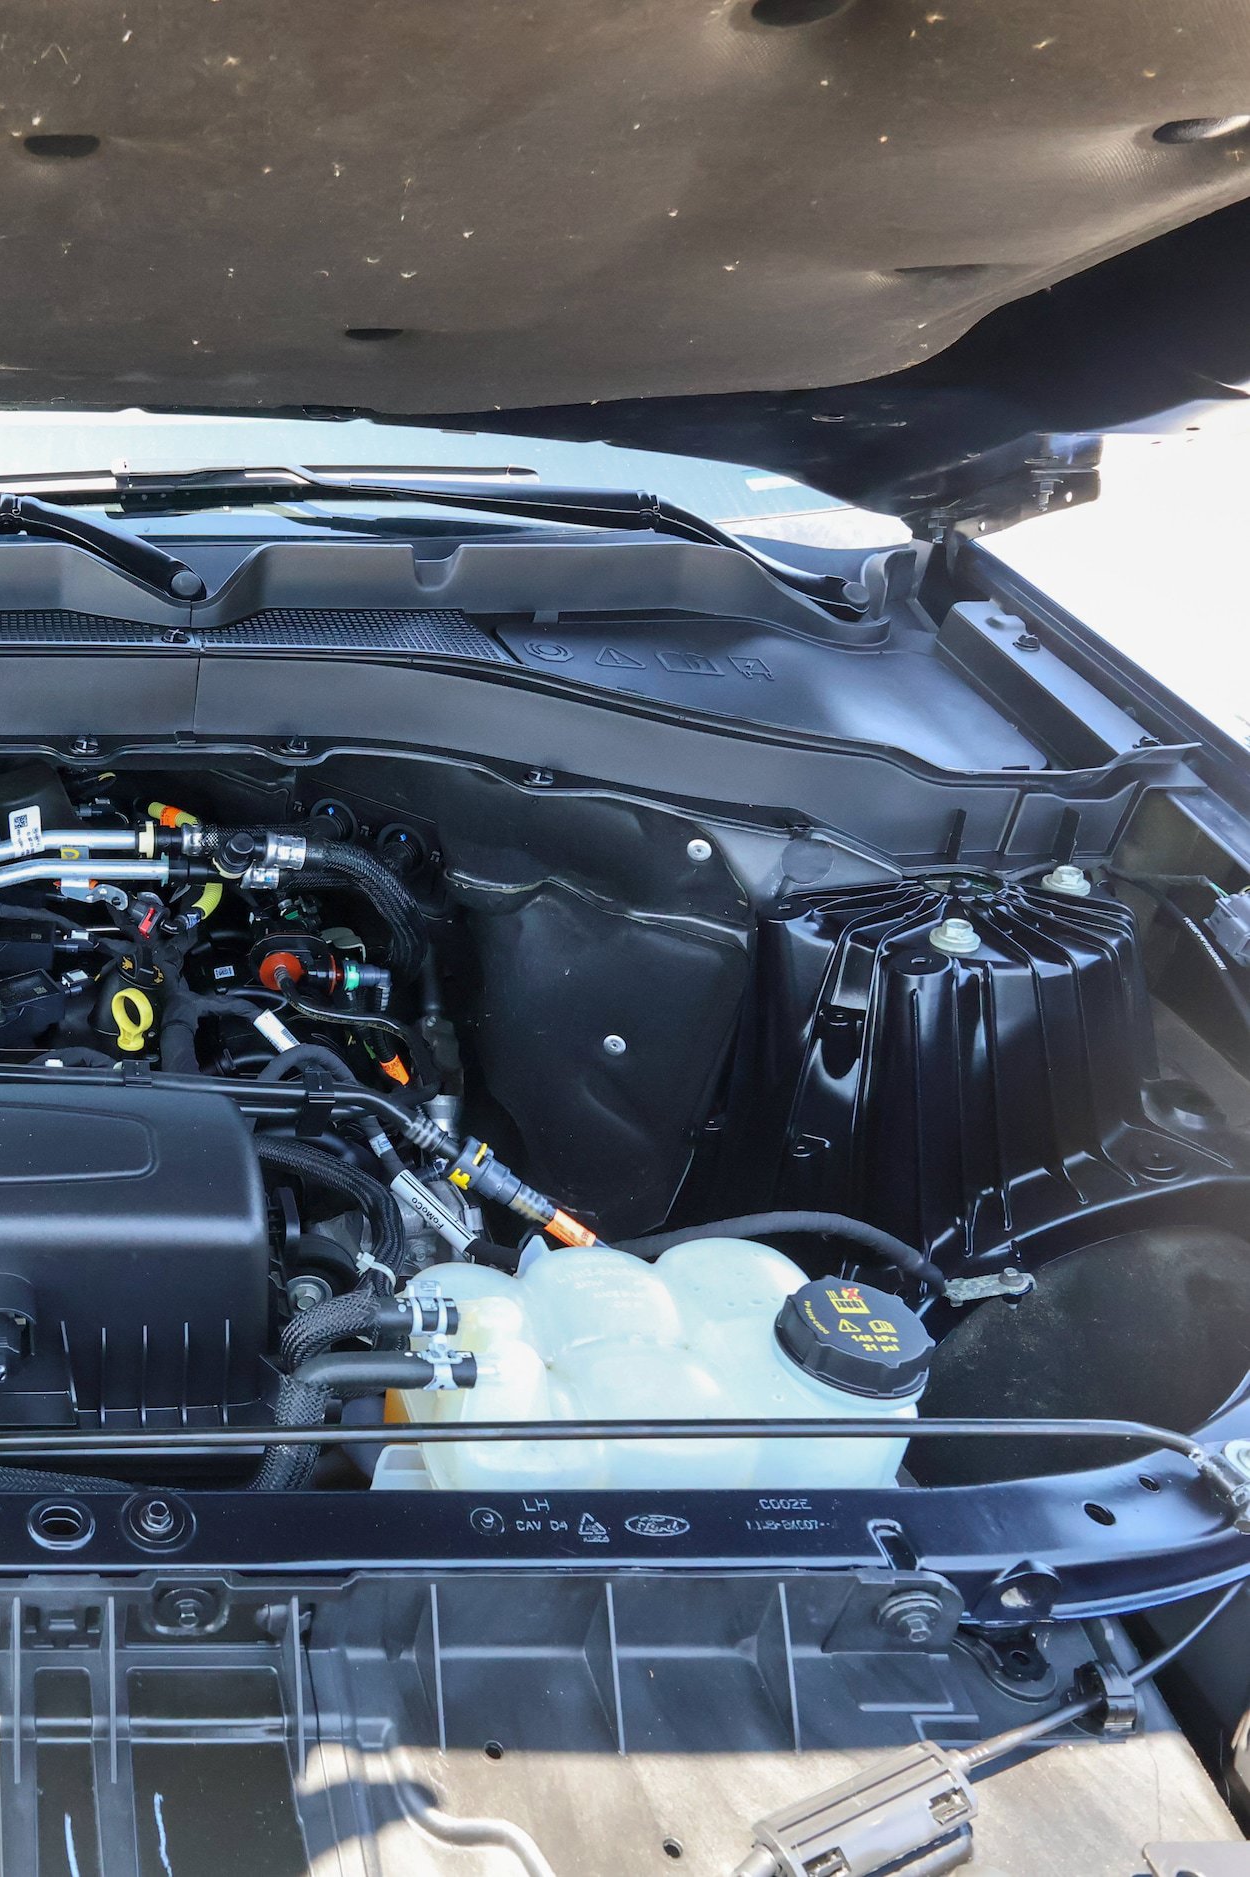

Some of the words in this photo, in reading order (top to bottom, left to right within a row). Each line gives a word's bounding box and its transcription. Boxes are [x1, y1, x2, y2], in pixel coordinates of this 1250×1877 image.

[412, 1197, 444, 1230] FoMoCo
[521, 1498, 551, 1512] LH
[515, 1519, 542, 1532] CAV
